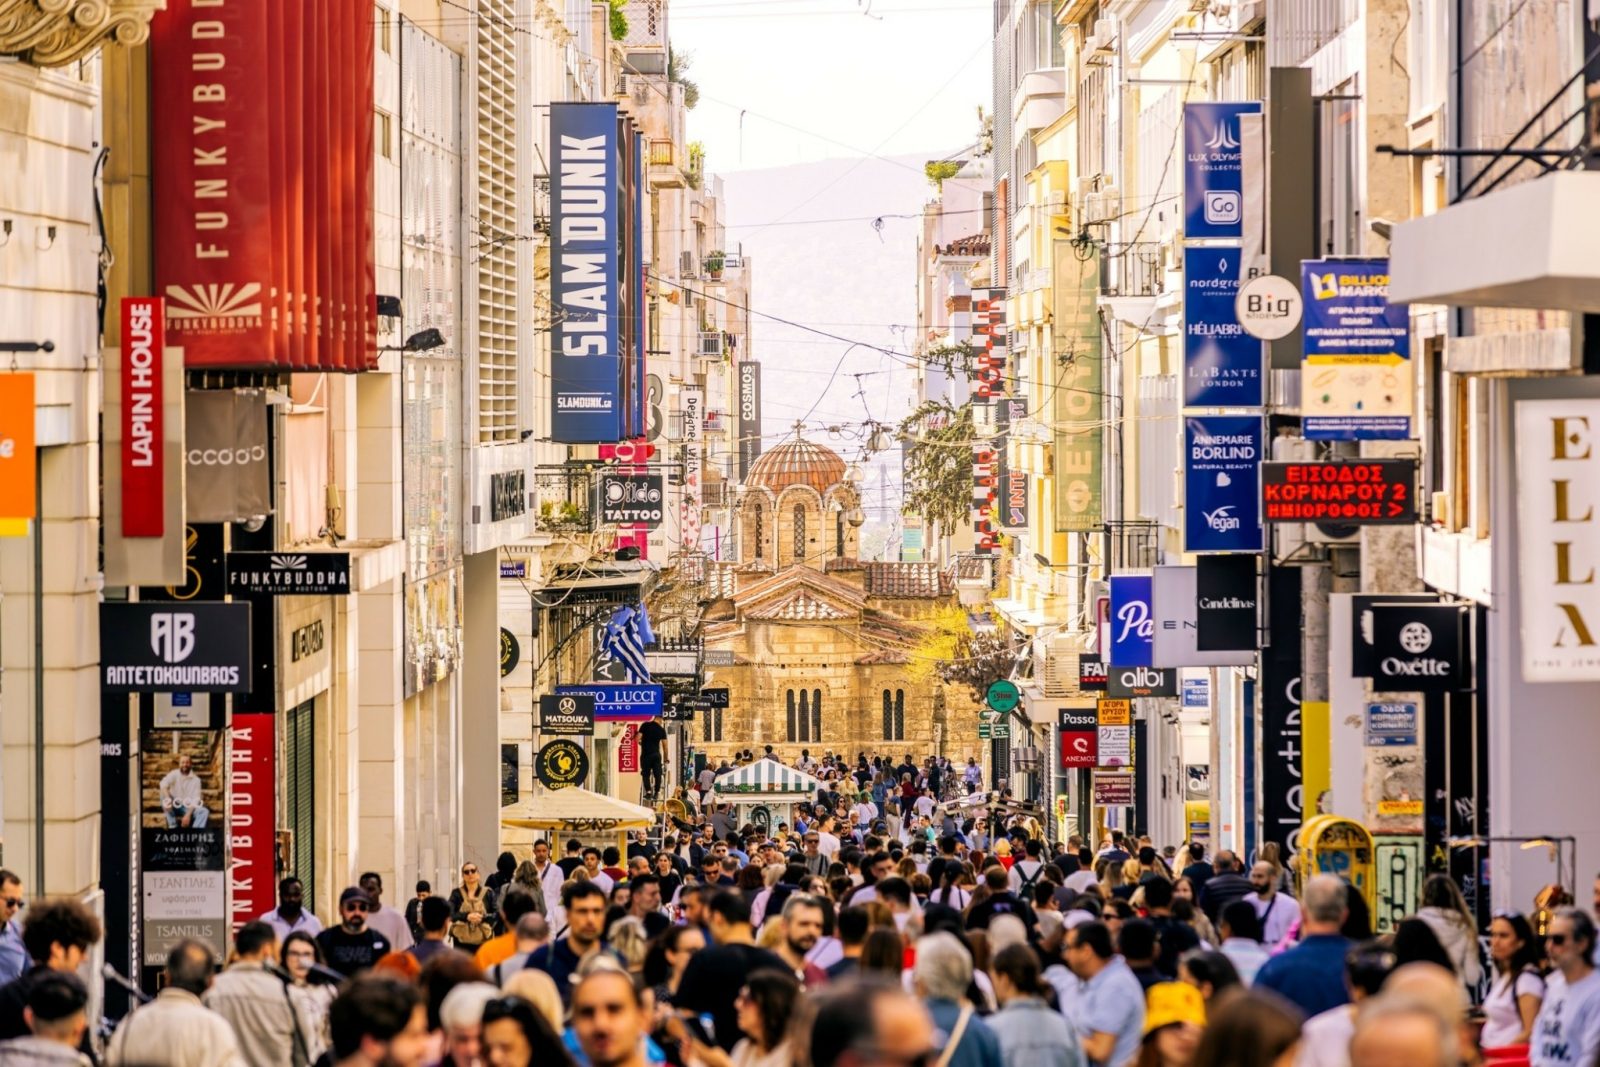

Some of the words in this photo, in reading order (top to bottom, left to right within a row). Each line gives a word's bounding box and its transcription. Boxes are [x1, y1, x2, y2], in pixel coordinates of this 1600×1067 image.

[1212, 198, 1235, 213] Go
[1190, 278, 1241, 289] nordgre
[1247, 295, 1289, 317] Big
[131, 303, 152, 388] HOUSE
[742, 366, 752, 421] COSMOS
[131, 392, 153, 467] LAPIN
[1193, 435, 1253, 445] ANNEMARIE
[1286, 465, 1383, 482] ΕΙΣΟΔΟΣ
[1264, 484, 1387, 500] ΚΟΡΝΑΡΟΥ
[1392, 484, 1406, 500] 2
[605, 510, 661, 520] TATTOO
[1267, 503, 1382, 517] ΗΜΙΟΡΟΦΟΣ
[1202, 505, 1239, 532] Vegan
[230, 572, 347, 585] FUNKYBUDDHA
[1117, 600, 1154, 643] Pa
[106, 666, 240, 685] ANTETOKOUNBROS
[1121, 667, 1164, 688] alibi
[615, 691, 655, 702] LUCCI
[545, 715, 589, 723] MATSOUKA
[155, 833, 215, 843] ΖΑΦΕΙΡΗΣ
[153, 878, 216, 889] ΤΣΑΝΤΙΛΗΣ
[156, 925, 214, 937] TSANTILIS
